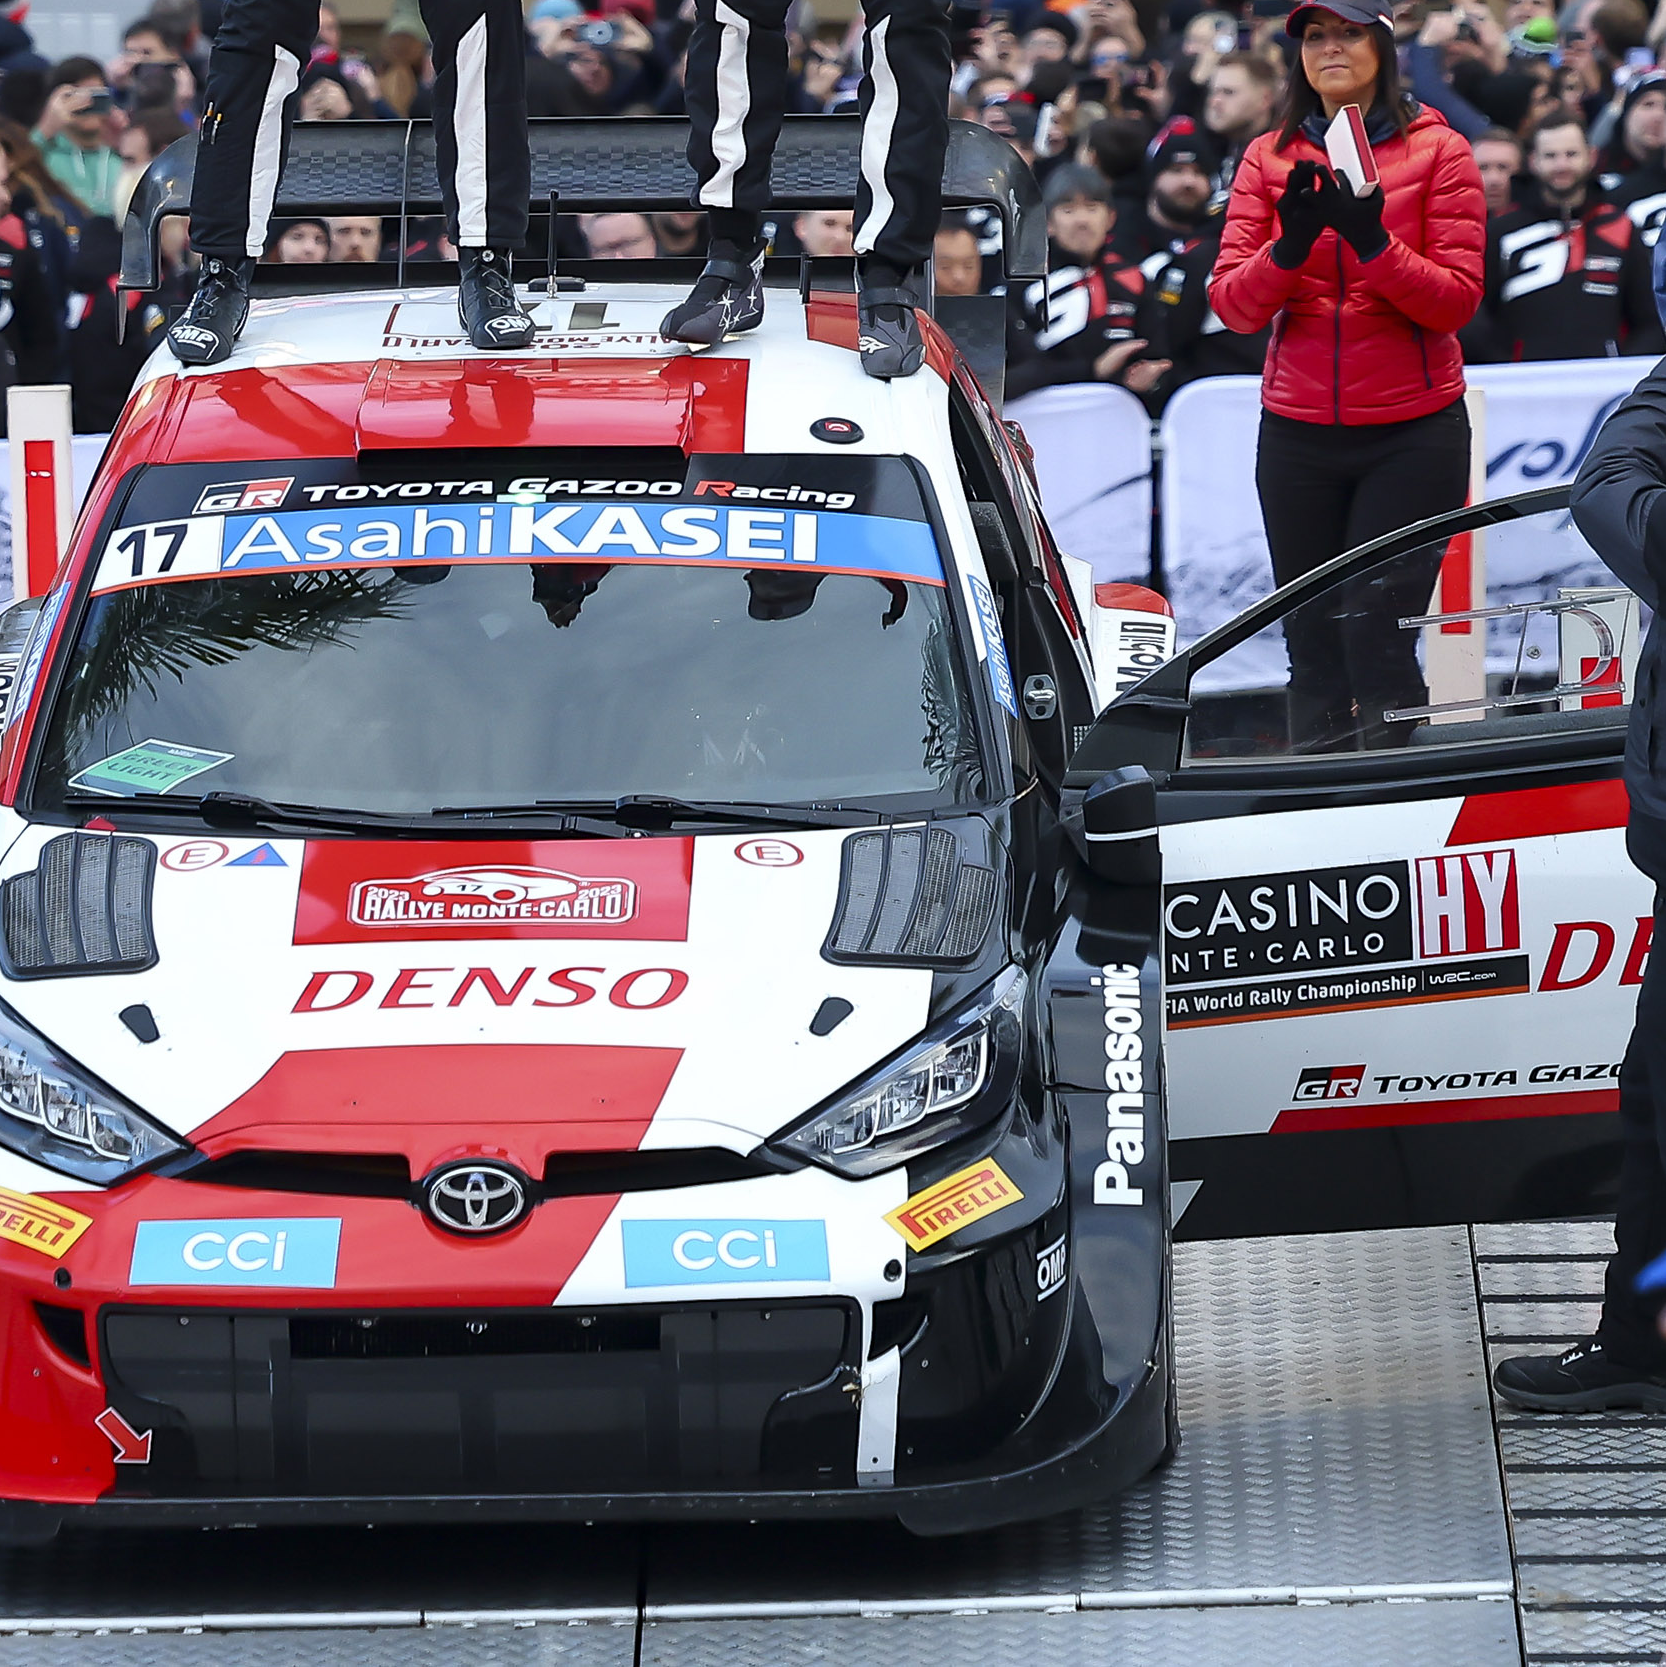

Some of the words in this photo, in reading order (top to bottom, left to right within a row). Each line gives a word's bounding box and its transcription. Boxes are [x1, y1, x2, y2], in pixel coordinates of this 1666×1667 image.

[199, 488, 286, 511] GR
[303, 480, 493, 502] TOYOTA
[508, 477, 682, 495] GAZOO
[694, 480, 856, 509] Racing
[116, 524, 189, 577] 17
[364, 895, 444, 920] RALLYE
[451, 894, 621, 918] MONTE-CARLO
[367, 886, 409, 902] 2023
[457, 884, 483, 892] 17
[578, 885, 621, 900] 2023
[1165, 875, 1400, 939] CASINO
[1419, 851, 1511, 955] HY
[291, 966, 689, 1014] DENSO
[1194, 990, 1242, 1012] World
[1249, 988, 1292, 1006] Rally
[1297, 974, 1417, 1000] Championship
[1092, 964, 1144, 1206] Panasonic
[1373, 1070, 1517, 1094] TOYOTA
[897, 1169, 1011, 1239] PIRELLI
[1037, 1248, 1067, 1290] OMP
